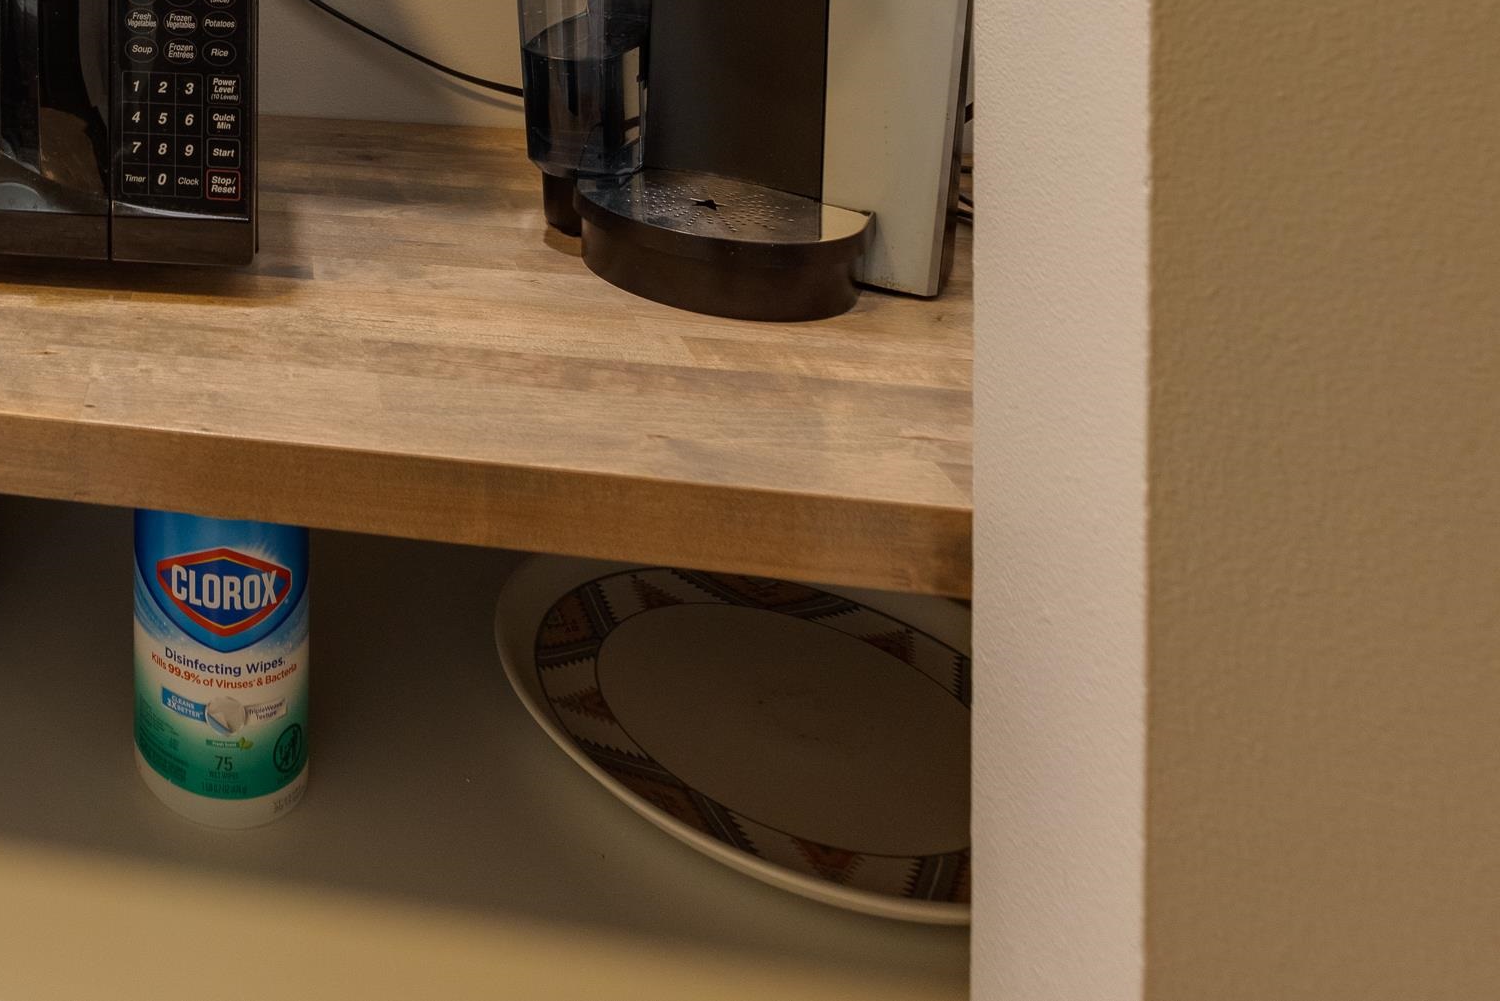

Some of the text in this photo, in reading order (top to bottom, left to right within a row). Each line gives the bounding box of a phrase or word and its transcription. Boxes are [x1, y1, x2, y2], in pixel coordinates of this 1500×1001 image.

[132, 12, 152, 20] Fresh
[169, 13, 192, 21] Frozen
[127, 19, 157, 28] Vegetables
[166, 21, 196, 30] Vegetables
[204, 19, 235, 28] Potatoes
[131, 44, 153, 54] Soup
[168, 43, 194, 51] Frozen
[210, 48, 229, 57] Rice
[212, 77, 236, 86] Power
[133, 80, 195, 95] 1 2 3
[213, 85, 235, 93] Level
[131, 111, 195, 126] 4 5 6
[212, 113, 236, 122] Quick
[216, 121, 231, 130] Min
[132, 141, 194, 157] 7 8 9
[212, 147, 235, 158] Start
[125, 173, 199, 186] Timer 0 Clock
[211, 175, 236, 185] Stop/
[211, 184, 236, 194] Reset
[171, 564, 277, 611] CLOROX
[165, 646, 242, 677] Disinfecting
[151, 652, 167, 670] Kills
[167, 664, 201, 684] 99.9%
[202, 678, 213, 687] of
[256, 677, 263, 687] &
[265, 662, 298, 684] Bacteria
[214, 755, 233, 772] 75
